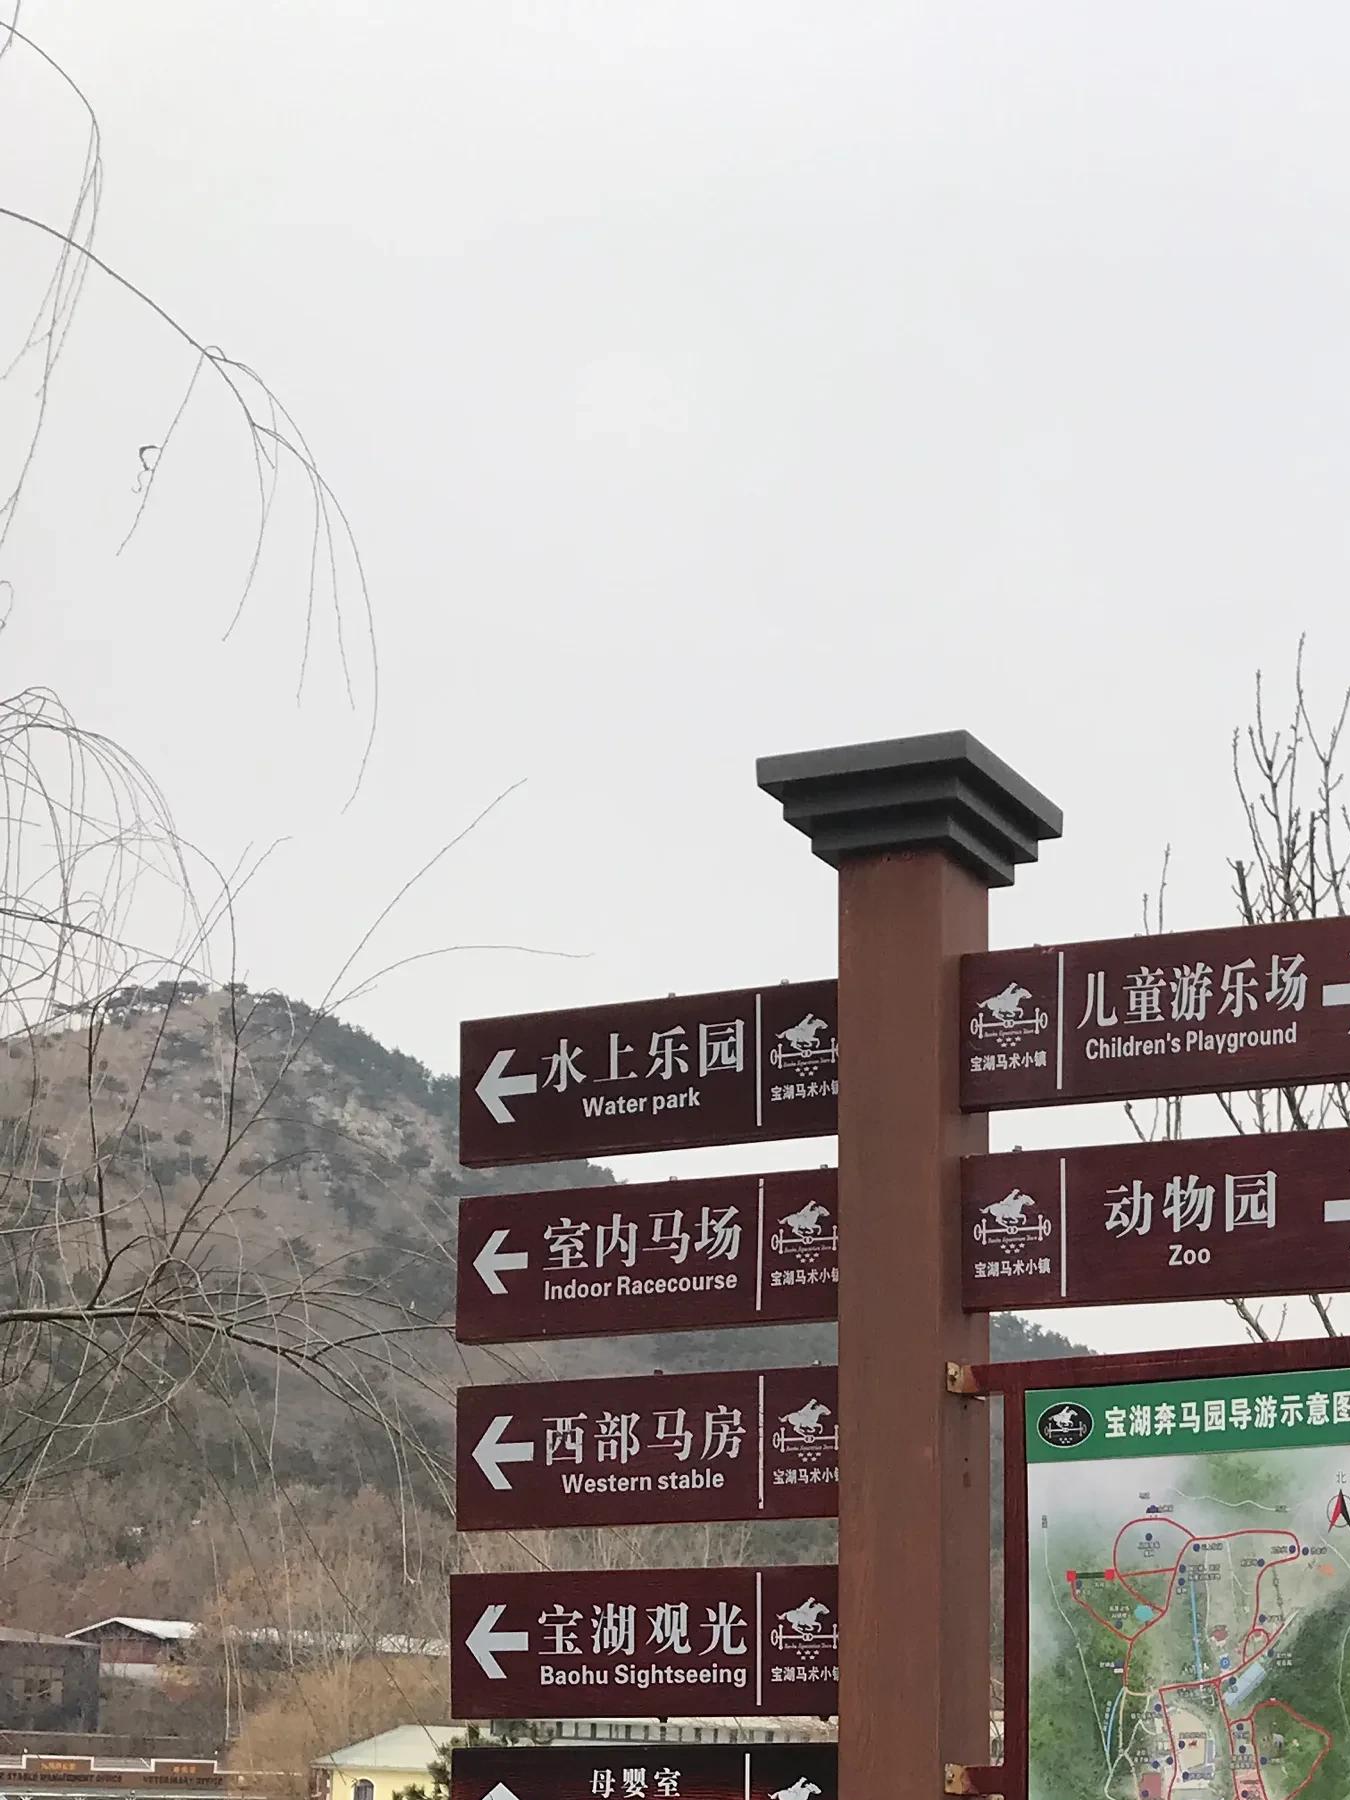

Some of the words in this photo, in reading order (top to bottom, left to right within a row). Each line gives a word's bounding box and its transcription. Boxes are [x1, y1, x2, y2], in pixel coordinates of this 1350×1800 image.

[1077, 953, 1308, 1031] 儿童游乐场
[541, 1018, 745, 1093] 水上乐园
[1086, 1032, 1181, 1060] Children's
[1186, 1022, 1297, 1055] Playground
[970, 1050, 1047, 1072] 宝湖马术小镇
[582, 1096, 648, 1118] Water
[652, 1086, 700, 1115] park
[1103, 1170, 1278, 1239] 动物园
[543, 1206, 742, 1272] 室内马场
[1168, 1244, 1211, 1266] Zoo
[974, 1257, 1051, 1278] 宝湖马术小镇
[544, 1278, 612, 1301] Indoor
[616, 1271, 738, 1296] Racecourse
[542, 1405, 747, 1466] 西部马房
[561, 1473, 652, 1494] Western
[657, 1468, 725, 1490] stable
[1335, 1471, 1347, 1484] 北
[538, 1601, 748, 1656] 宝湖观光
[540, 1664, 608, 1685] Baohu
[614, 1663, 747, 1689] Sightseeing
[591, 1767, 681, 1799] 母婴室
